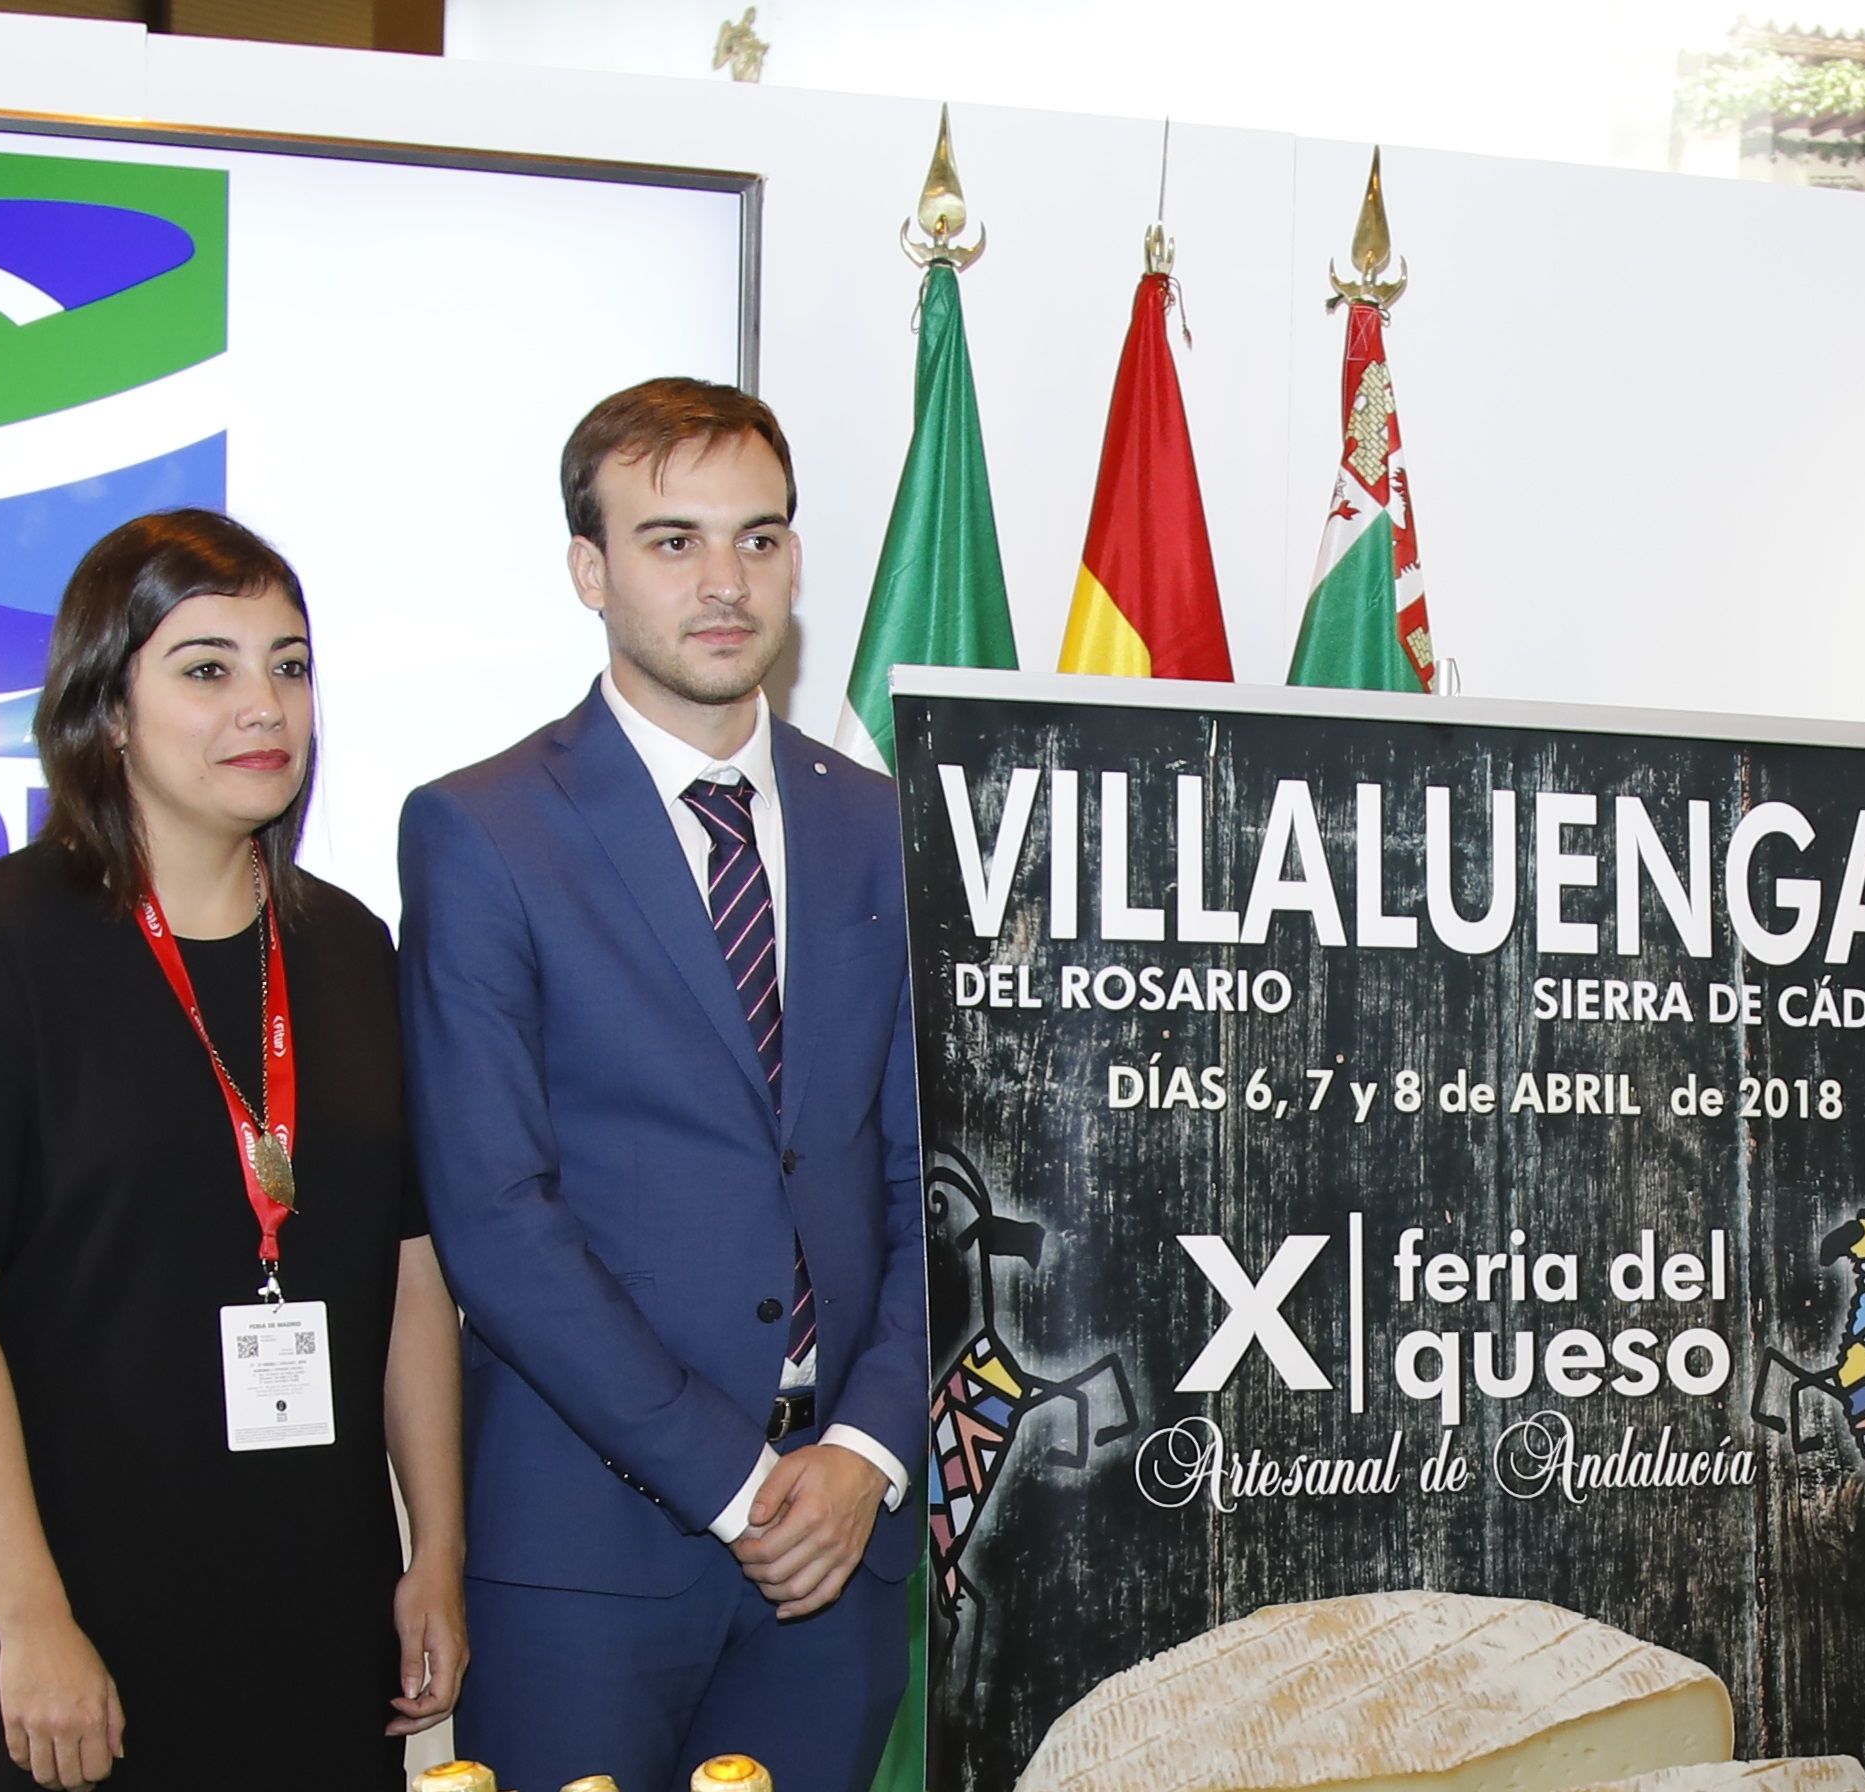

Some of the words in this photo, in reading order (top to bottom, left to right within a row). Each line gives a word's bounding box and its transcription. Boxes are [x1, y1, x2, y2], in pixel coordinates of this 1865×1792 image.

[953, 962, 1045, 1011] DEL
[1059, 966, 1293, 1017] ROSARIO
[1533, 976, 1697, 1025] SIERRA
[1707, 982, 1765, 1027] DE
[1107, 1052, 1229, 1112] DÍAS
[1244, 1066, 1288, 1121] 6,
[1305, 1068, 1336, 1111] 7
[1349, 1081, 1379, 1125] y
[1393, 1070, 1422, 1112] 8
[1437, 1067, 1495, 1114] de
[1509, 1070, 1642, 1117] ABRIL
[1669, 1075, 1725, 1120] de
[1738, 1078, 1844, 1122] 2018
[1173, 1233, 1336, 1394] X
[1392, 1227, 1580, 1305] feria
[1609, 1228, 1728, 1302] del
[1392, 1323, 1733, 1427] queso
[1135, 1414, 1403, 1514] Artesanal
[1417, 1437, 1470, 1494] de
[1491, 1407, 1758, 1502] Andalucía
